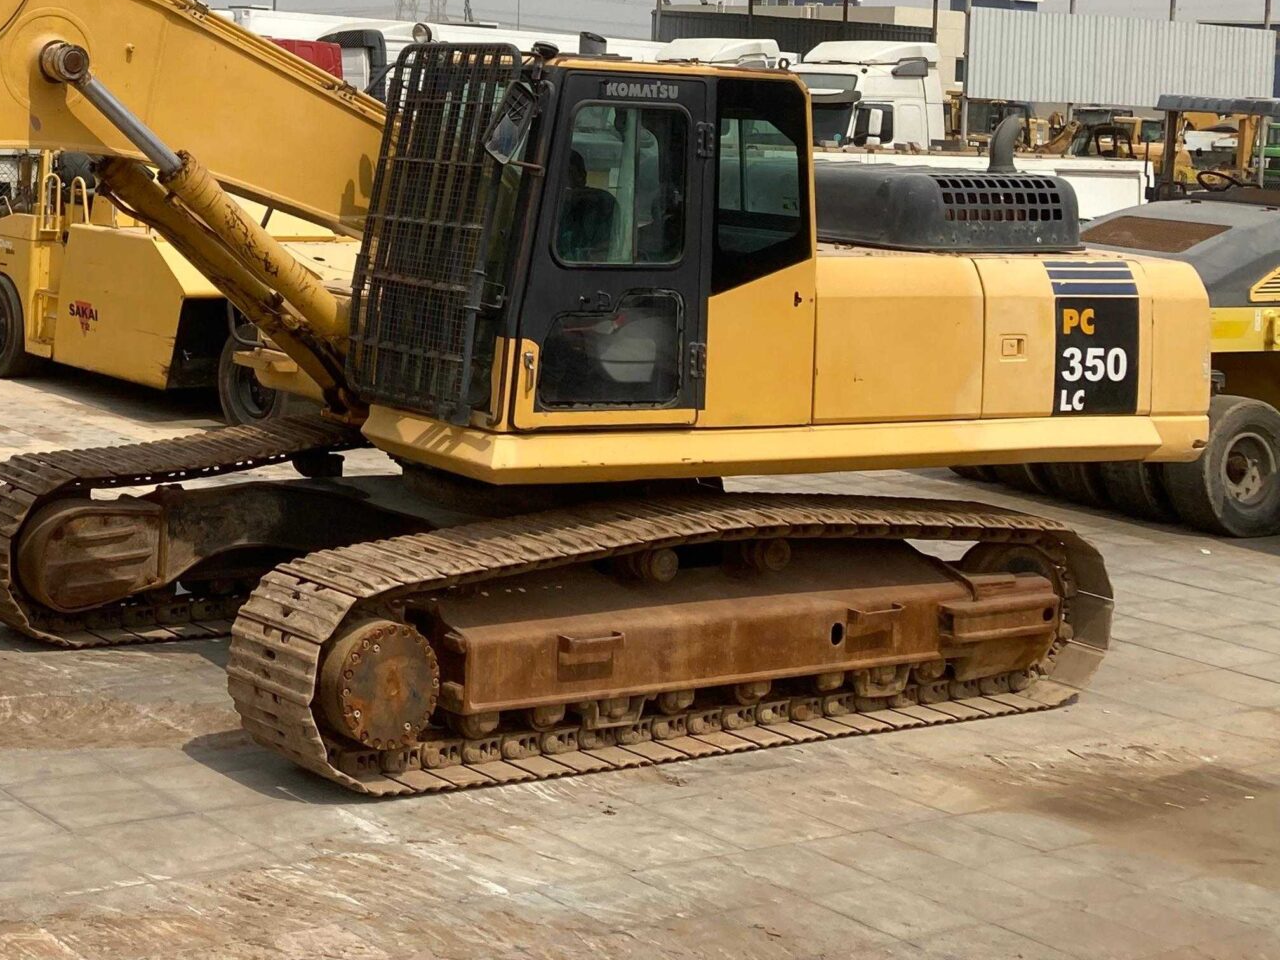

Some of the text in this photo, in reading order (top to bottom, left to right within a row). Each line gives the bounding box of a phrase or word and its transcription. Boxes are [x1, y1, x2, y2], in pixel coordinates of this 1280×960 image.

[606, 81, 679, 99] KOMATSU
[69, 303, 99, 321] SAKAI
[1063, 308, 1095, 335] PC
[1061, 346, 1128, 382] 350
[1059, 389, 1086, 412] LC
